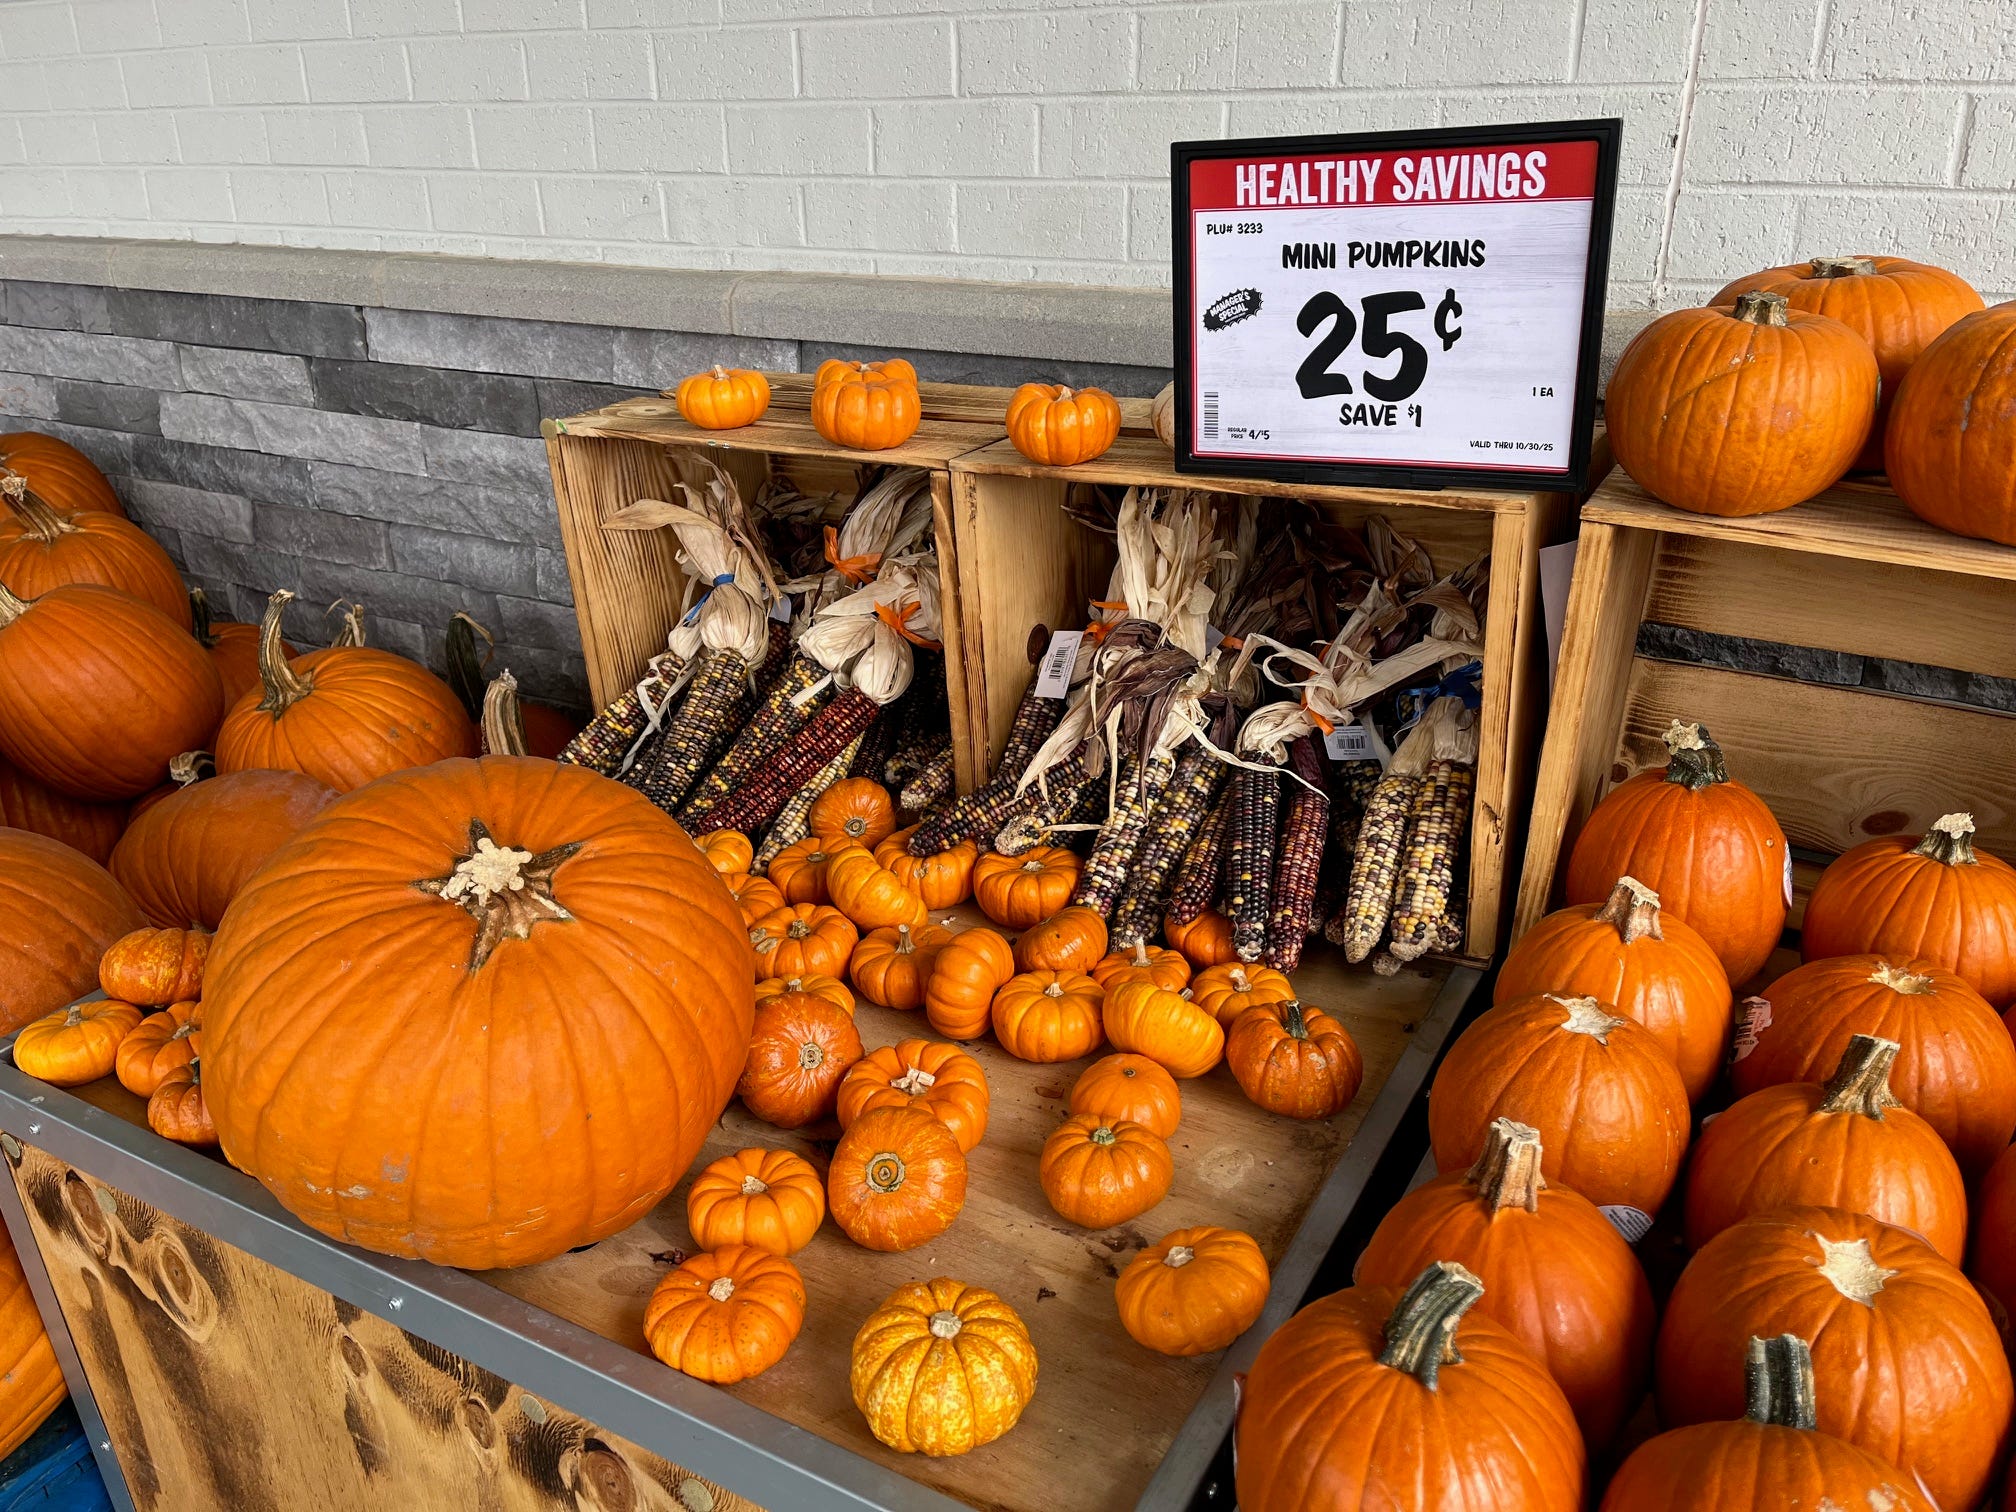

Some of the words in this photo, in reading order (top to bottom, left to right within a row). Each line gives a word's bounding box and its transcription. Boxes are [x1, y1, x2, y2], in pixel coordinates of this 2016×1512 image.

[1235, 158, 1382, 206] HEALTHY
[1392, 150, 1547, 201] SAVINGS
[1206, 223, 1233, 235] PLU#
[1237, 222, 1263, 234] 3233
[1282, 242, 1336, 269] MINI
[1347, 239, 1486, 268] PUMPKINS
[1209, 291, 1251, 318] MANAGER'S
[1218, 302, 1249, 322] SPECIAL
[1532, 386, 1536, 397] 1
[1540, 387, 1554, 397] EA
[1339, 403, 1398, 427] SAVE
[1407, 403, 1422, 428] $1
[1469, 440, 1491, 449] VALID
[1494, 441, 1514, 450] THRU
[1516, 441, 1554, 451] 10/30/25
